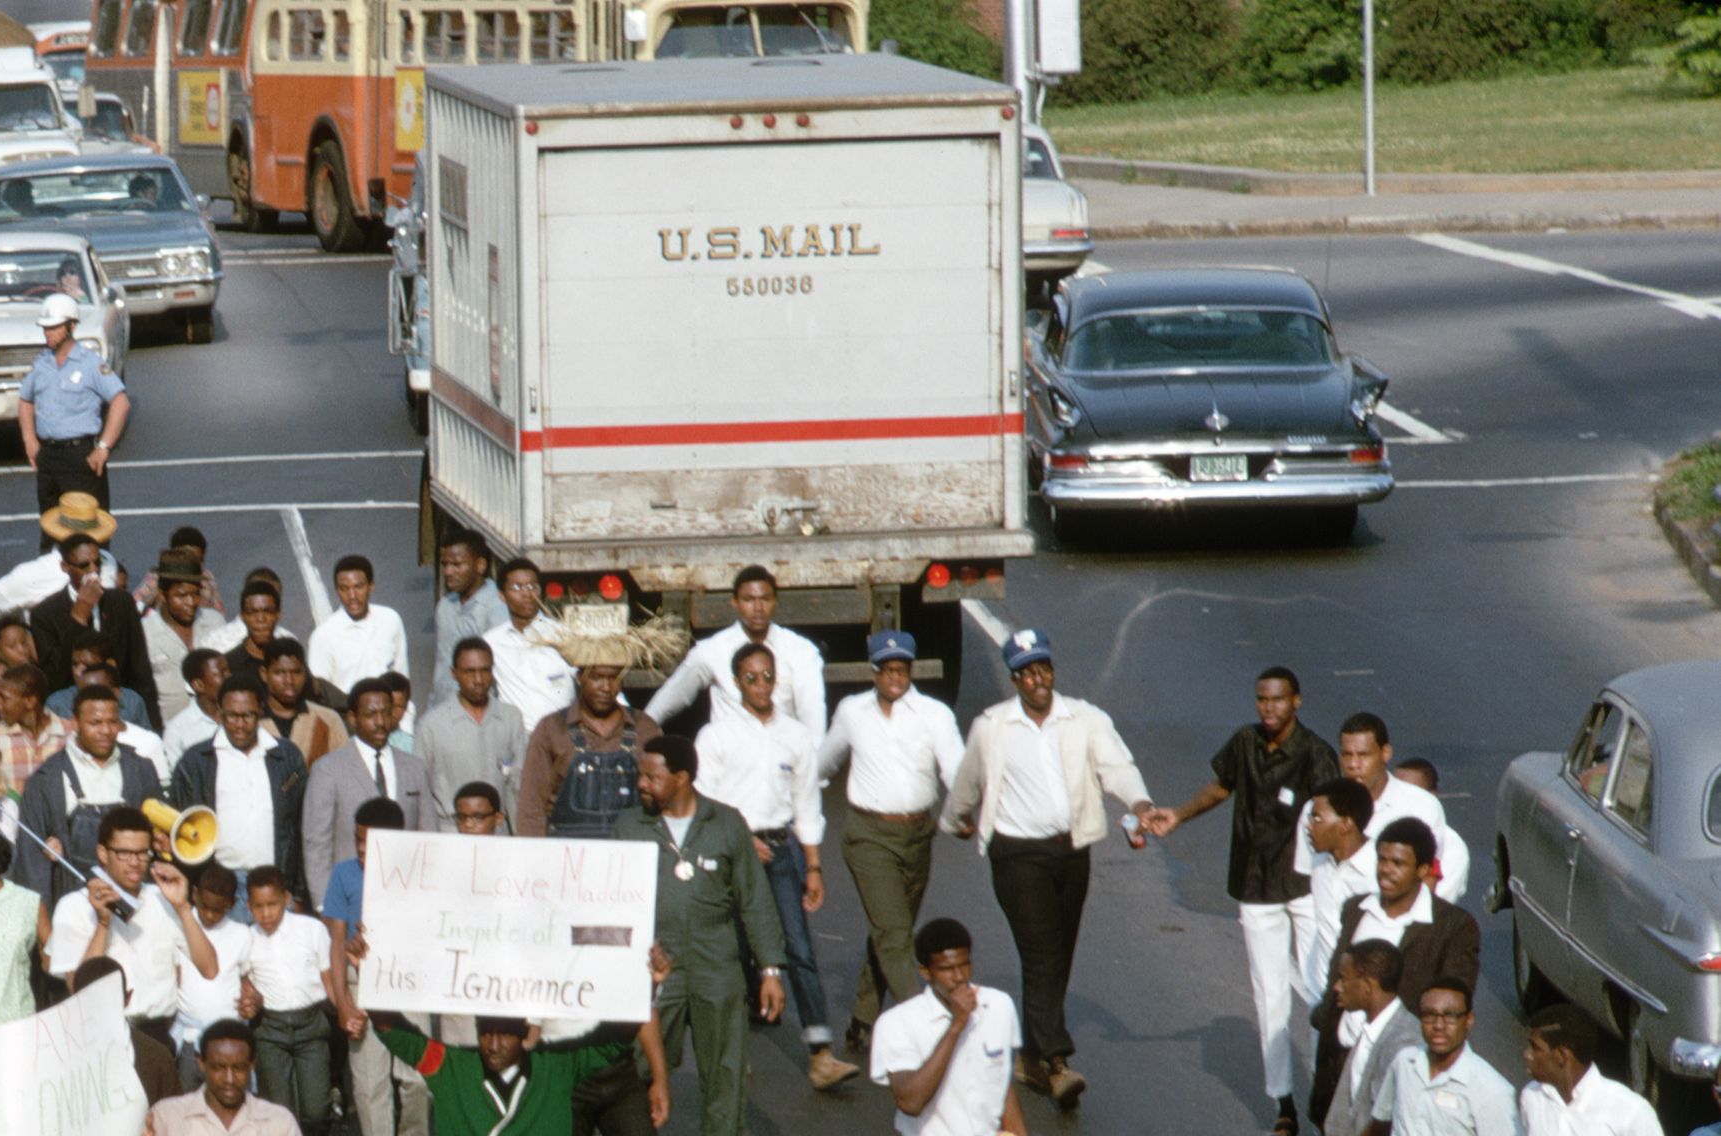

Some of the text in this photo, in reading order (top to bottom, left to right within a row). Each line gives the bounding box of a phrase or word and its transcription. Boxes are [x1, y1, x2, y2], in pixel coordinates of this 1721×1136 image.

[760, 223, 881, 258] MAIL
[376, 839, 649, 903] WE Love Maddox
[532, 908, 554, 947] of
